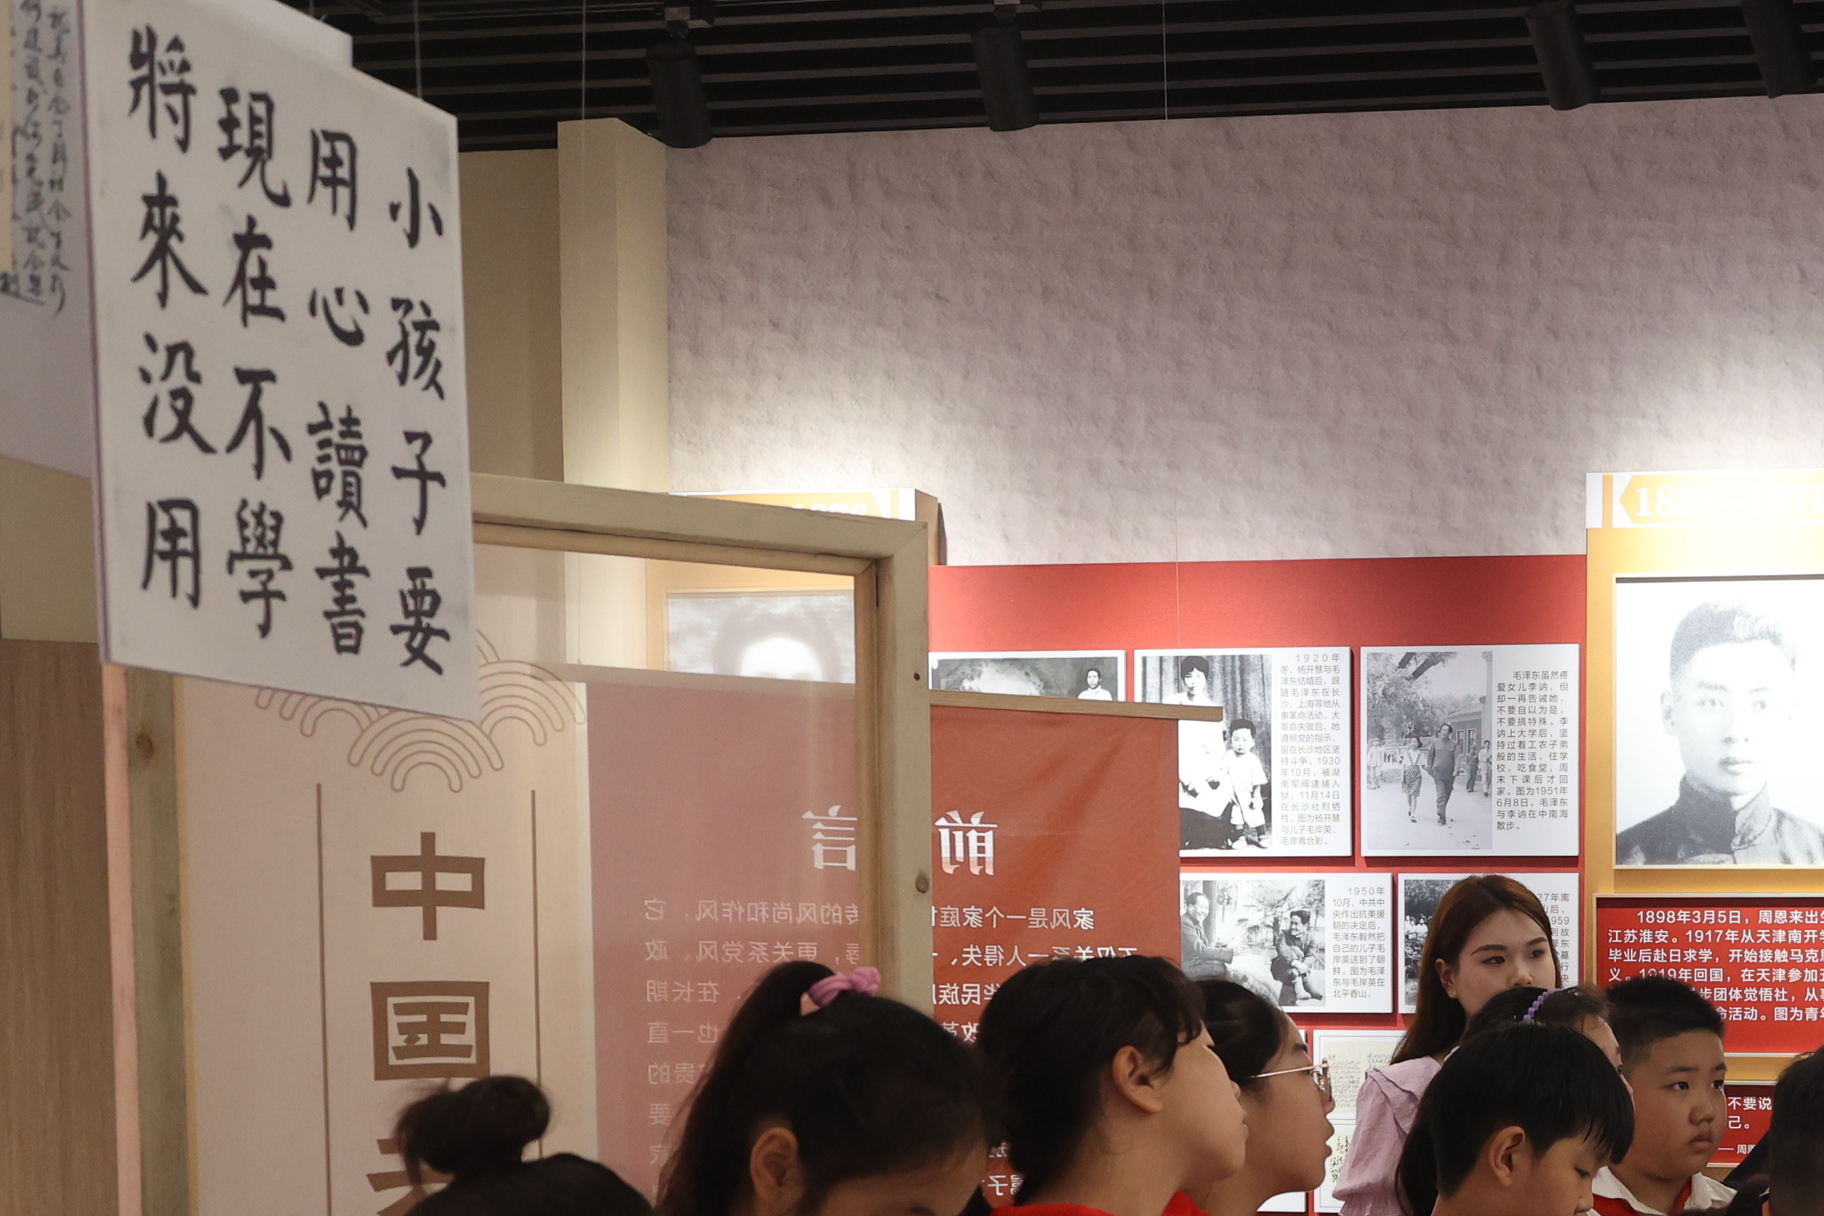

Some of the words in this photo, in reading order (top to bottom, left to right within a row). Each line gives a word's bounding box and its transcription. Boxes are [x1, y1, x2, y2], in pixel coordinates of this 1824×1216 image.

[218, 87, 293, 639] 現在不學
[307, 129, 370, 654] 用心讀書
[387, 168, 451, 674] 小孩子要
[1296, 653, 1340, 662] 1920年
[1281, 665, 1340, 674] 冬，杨开慧与毛
[1513, 671, 1568, 680] 毛泽东虽然疼
[1281, 676, 1340, 685] 泽东结婚后，跟
[1496, 683, 1568, 692] 爱女儿李讷，但
[1281, 688, 1340, 697] 随毛泽东在长
[1496, 694, 1564, 703] 却一再告诫她，
[1281, 699, 1340, 708] 沙、上海等地从
[1496, 706, 1564, 715] 不要自以为是，
[1281, 711, 1340, 720] 事革命活动。大
[1496, 717, 1568, 726] 不要搞特殊。李
[1281, 722, 1340, 731] 革命失败后，她
[1496, 729, 1568, 738] 讷上大学后，坚
[1496, 740, 1568, 749] 持过着工农子弟
[1281, 745, 1340, 754] 留在长沙地区坚
[1496, 752, 1568, 761] 般的生活，住学
[1281, 757, 1340, 766] 持斗争。1930
[1496, 763, 1568, 772] 校，吃食堂，周
[1281, 768, 1340, 777] 年10月，被湖
[1281, 779, 1340, 788] 南军阀逮捕入
[1496, 775, 1568, 784] 末下课后才回
[1281, 791, 1340, 800] 狱，11月14日
[1496, 787, 1568, 796] 家。图为1951年
[1281, 802, 1340, 811] 在长沙壮烈牺
[1496, 798, 1568, 807] 6月8日，毛泽东
[1281, 814, 1340, 823] 牲。图为杨开慧
[1496, 810, 1568, 819] 与李讷在中南海
[1281, 825, 1336, 834] 与儿子毛岸英、
[1496, 821, 1520, 830] 散步。
[1281, 837, 1328, 846] 毛岸青合影。
[1348, 887, 1385, 896] 1950年
[1332, 898, 1385, 907] 10月，中共中
[1332, 910, 1385, 919] 央作出抗美援
[1332, 921, 1380, 930] 朝的决定后，
[1332, 933, 1385, 941] 毛泽东毅然把
[1332, 944, 1385, 953] 自己的儿子毛
[1332, 955, 1385, 964] 岸英送到了朝
[1332, 967, 1385, 976] 鲜。图为毛泽
[1332, 978, 1385, 987] 东与毛岸英在
[1332, 989, 1371, 998] 北平香山。
[1727, 1096, 1772, 1111] 不要说
